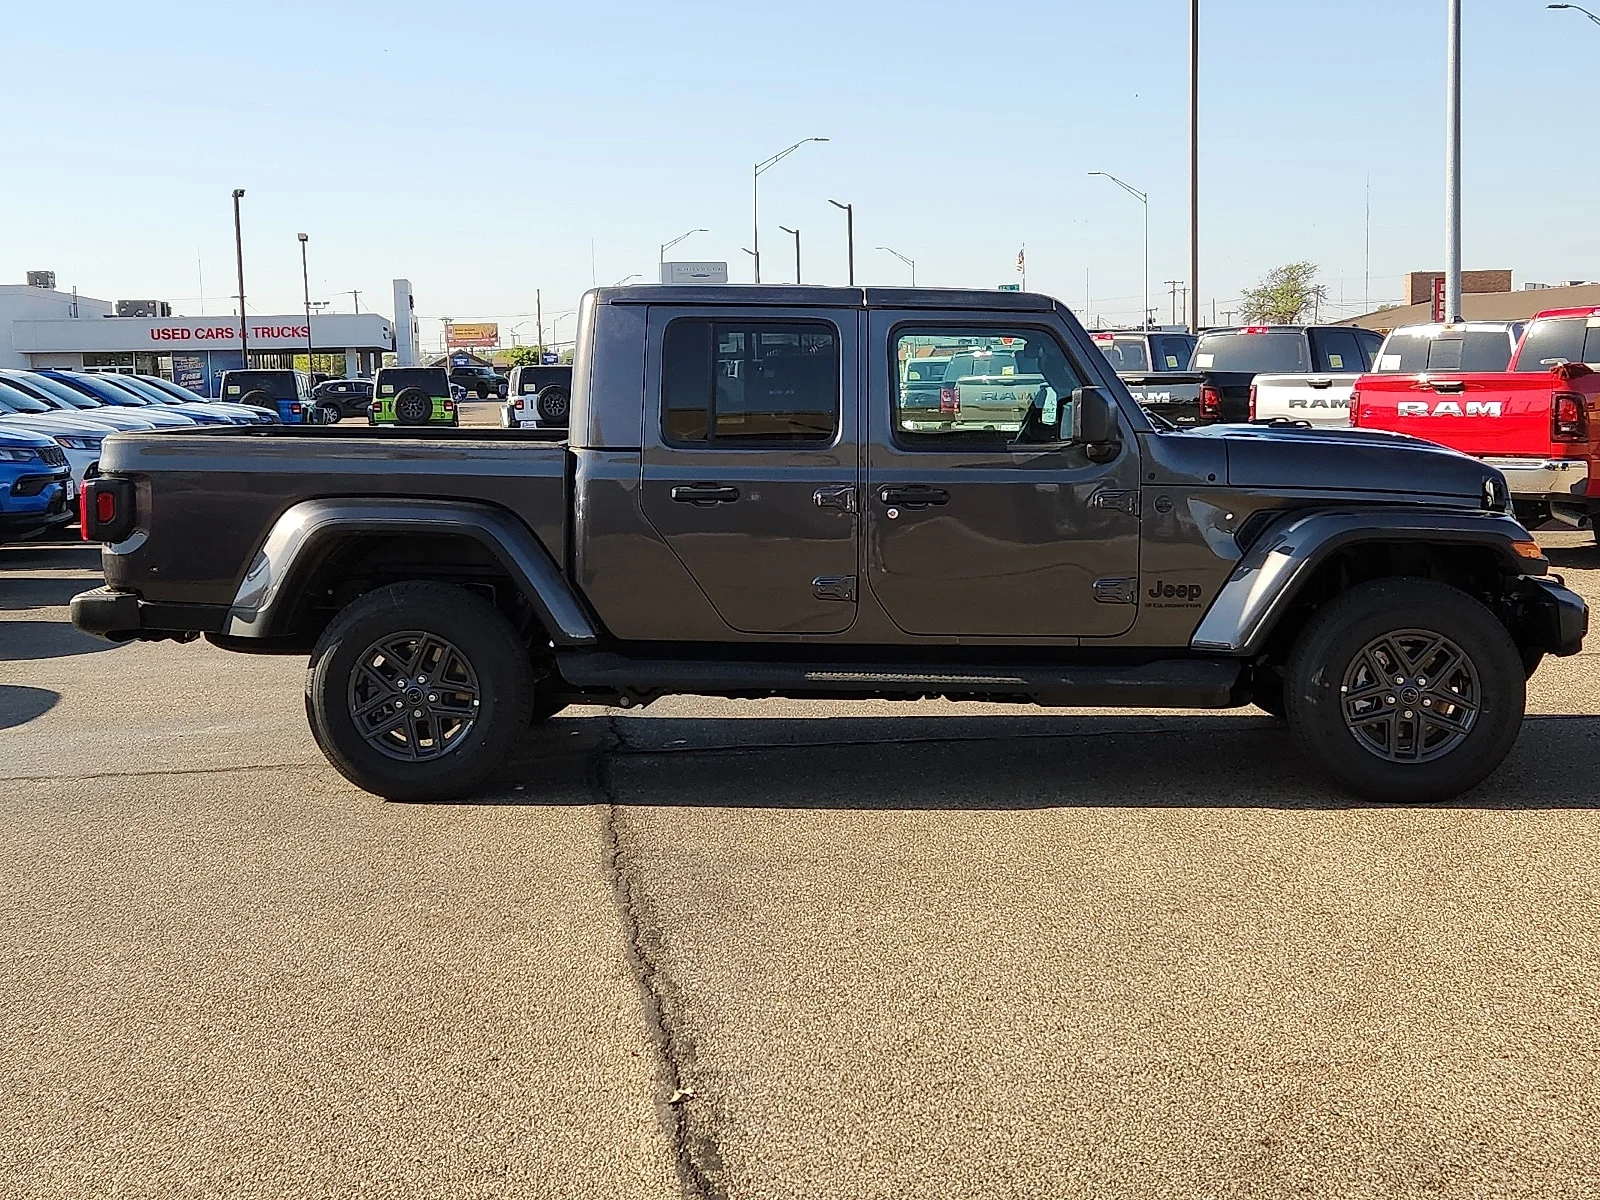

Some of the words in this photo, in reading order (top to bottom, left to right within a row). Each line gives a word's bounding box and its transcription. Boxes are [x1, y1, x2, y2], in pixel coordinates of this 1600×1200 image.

[151, 328, 191, 340] USED
[195, 327, 234, 339] CARS
[252, 326, 309, 339] TRUCKS
[1131, 392, 1170, 403] AM
[1289, 399, 1351, 408] RAM
[1397, 401, 1502, 417] RAM
[1148, 580, 1202, 602] Jeep
